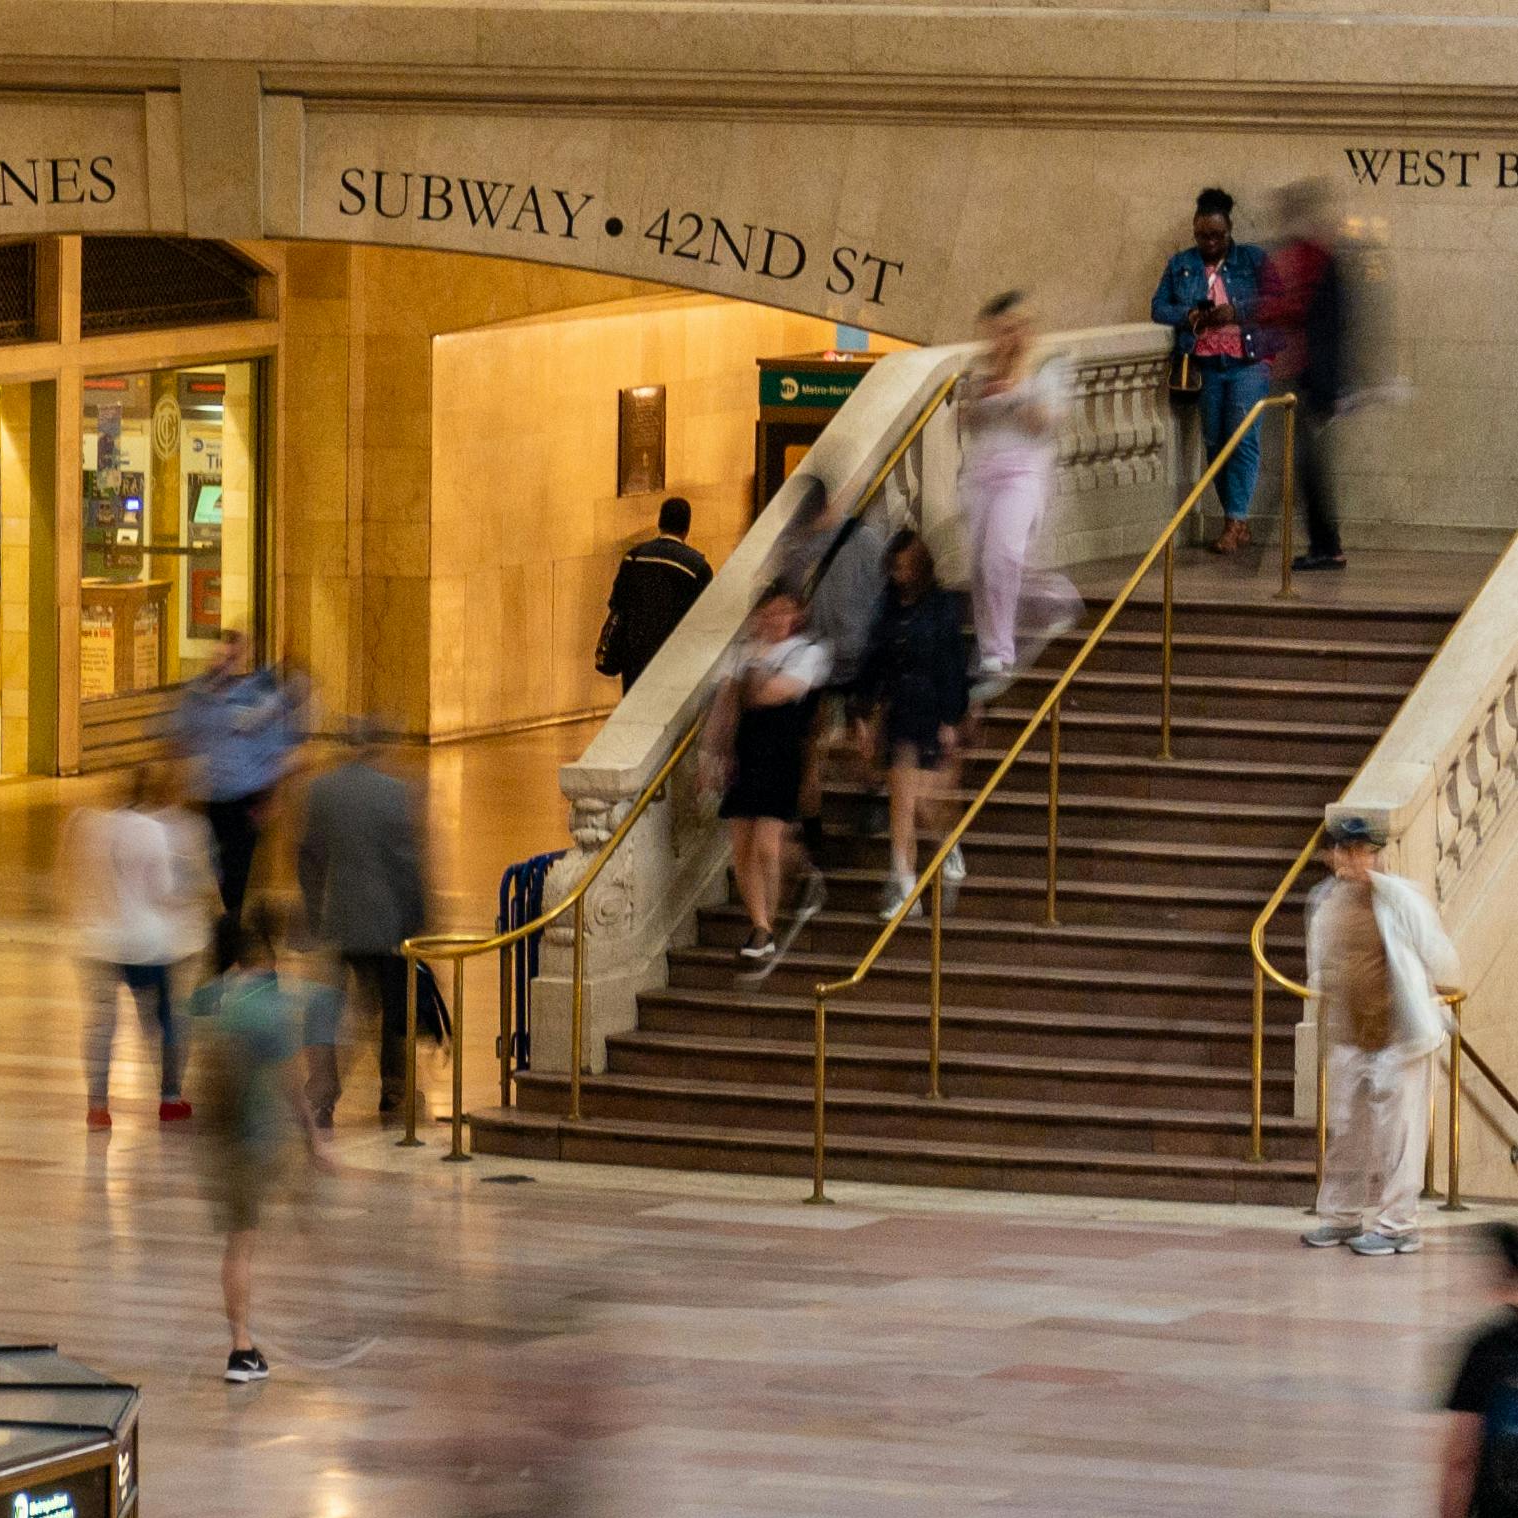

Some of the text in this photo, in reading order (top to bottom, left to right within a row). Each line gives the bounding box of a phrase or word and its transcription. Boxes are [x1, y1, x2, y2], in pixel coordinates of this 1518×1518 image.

[1344, 149, 1479, 187] WEST
[339, 168, 903, 305] SUBWAY 42ND ST
